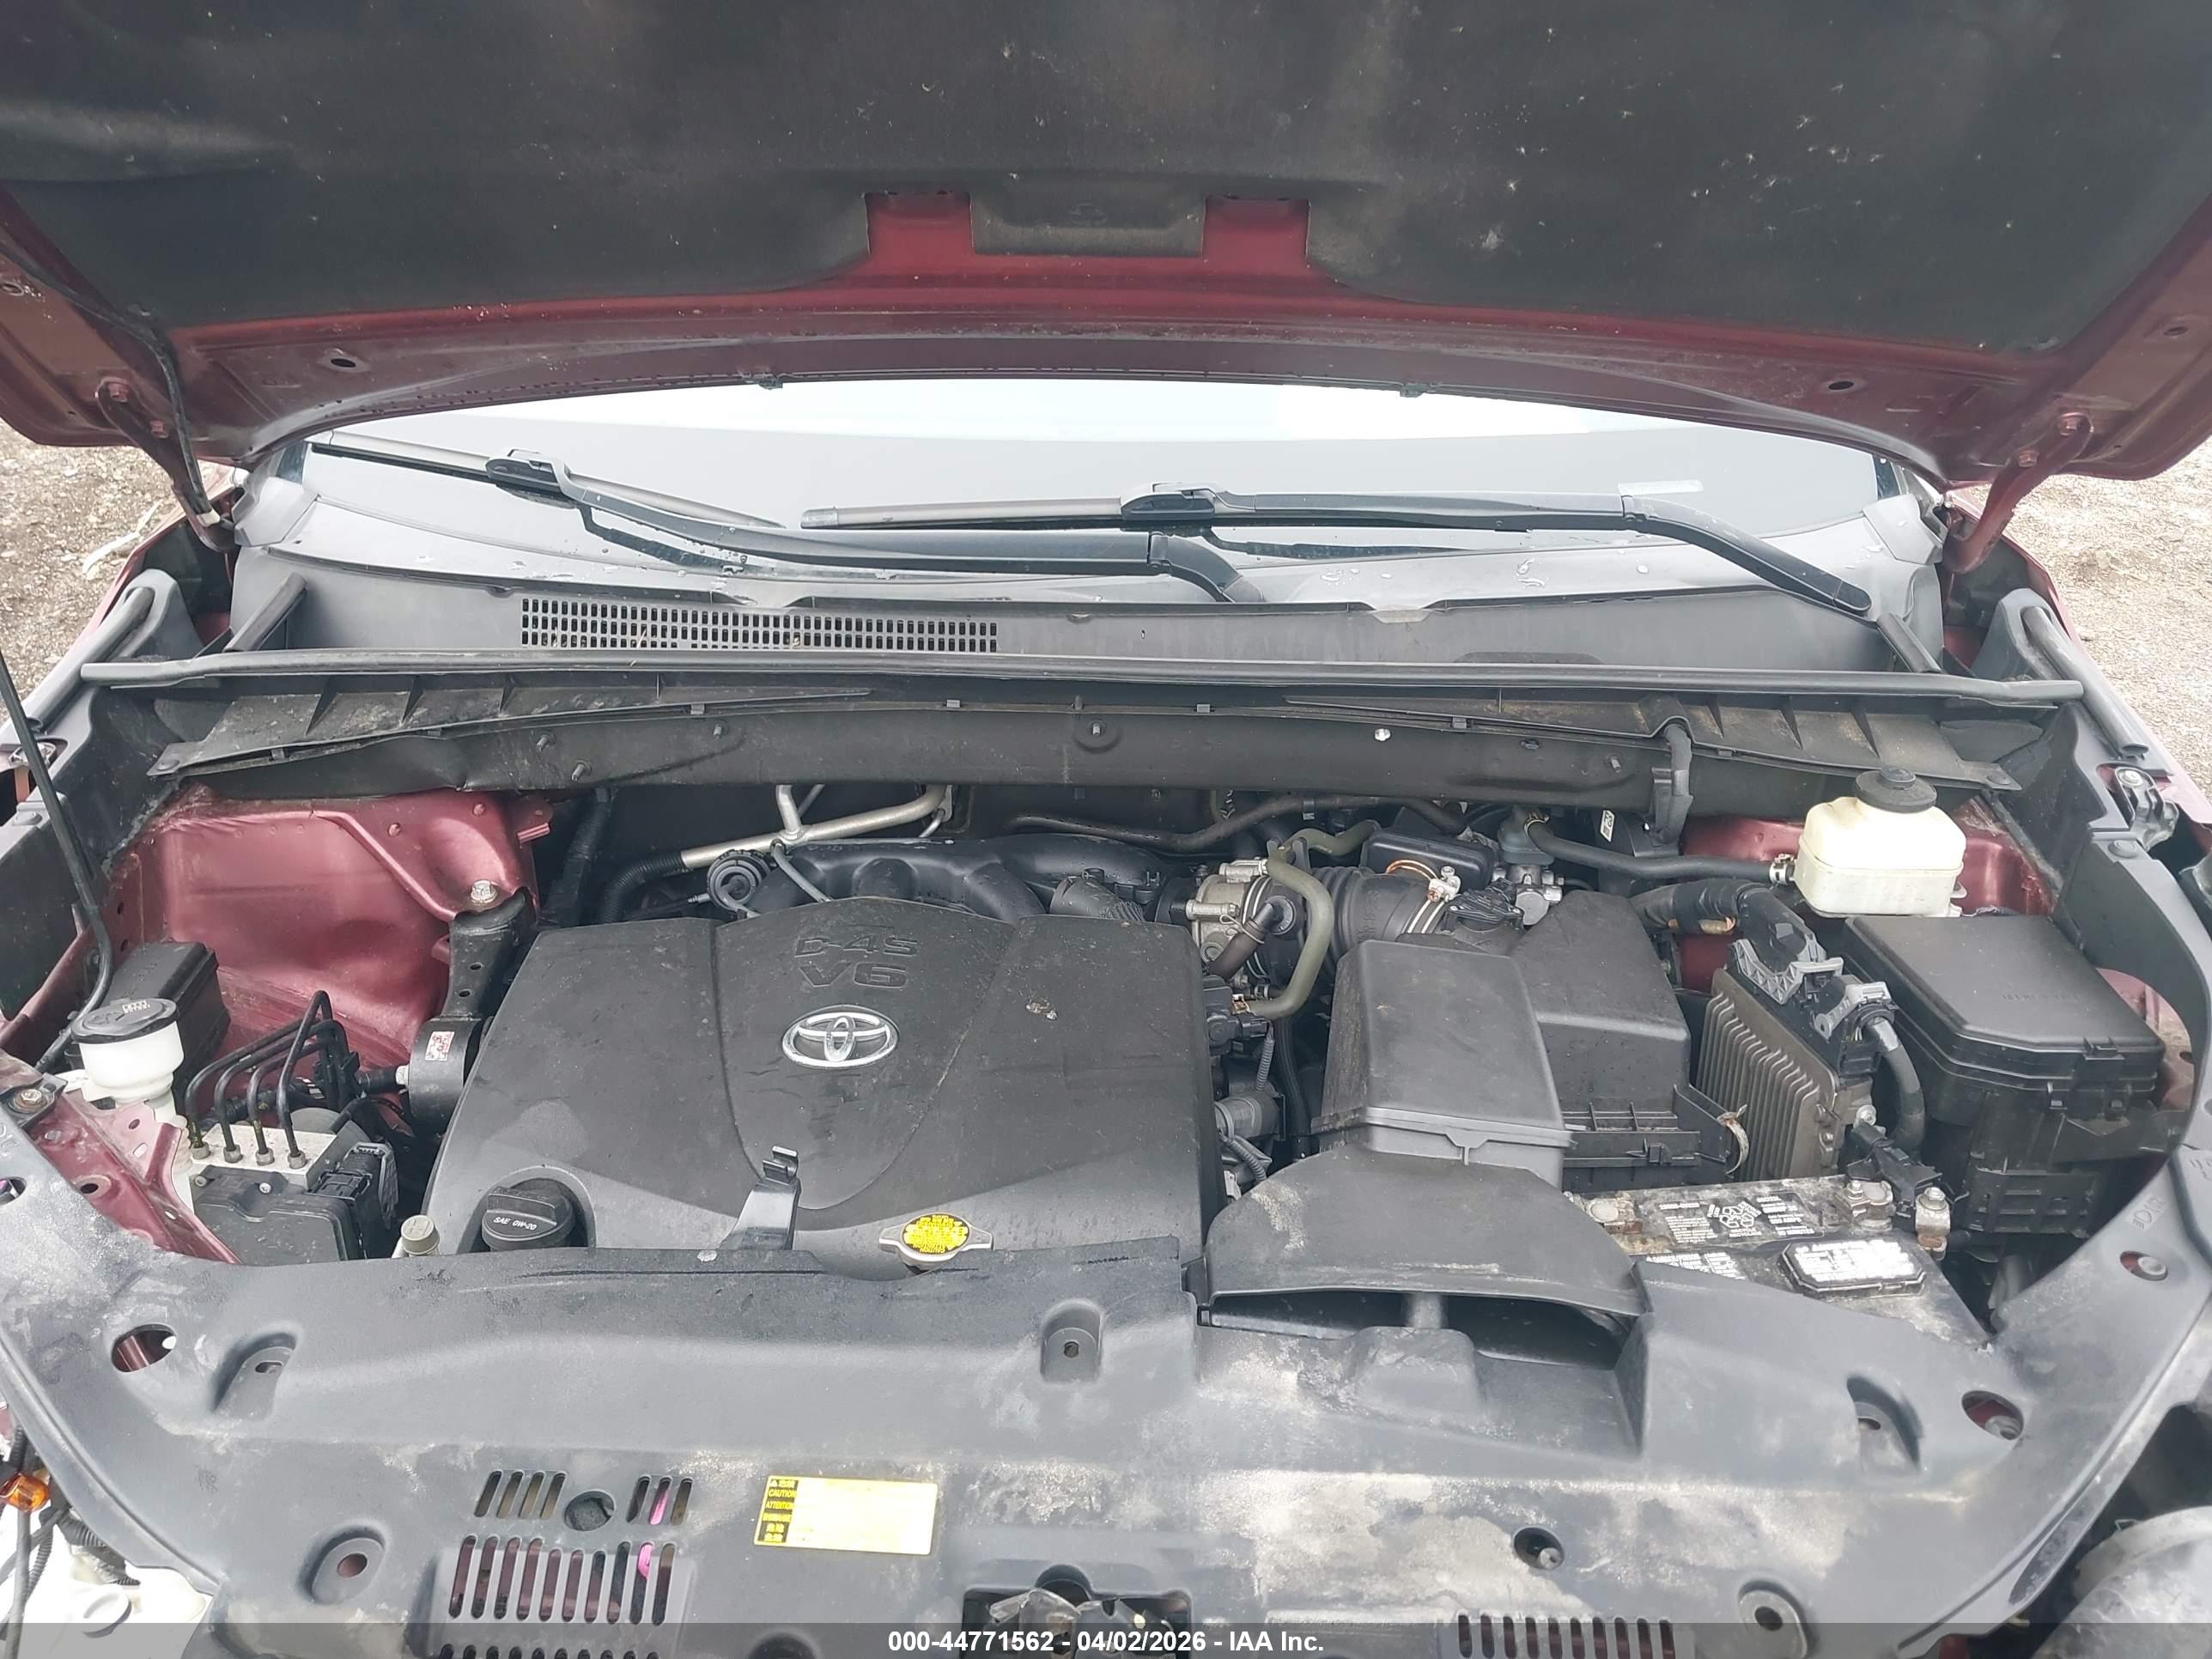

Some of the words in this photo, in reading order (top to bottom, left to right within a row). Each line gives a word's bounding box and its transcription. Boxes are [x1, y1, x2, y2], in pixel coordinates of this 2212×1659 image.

[793, 935, 918, 957] D-4S
[798, 961, 908, 988] V6
[493, 1216, 512, 1224] SAE
[513, 1219, 537, 1231] 0W-20
[768, 1489, 797, 1498] CAUTION
[766, 1500, 795, 1510] ATTENTION
